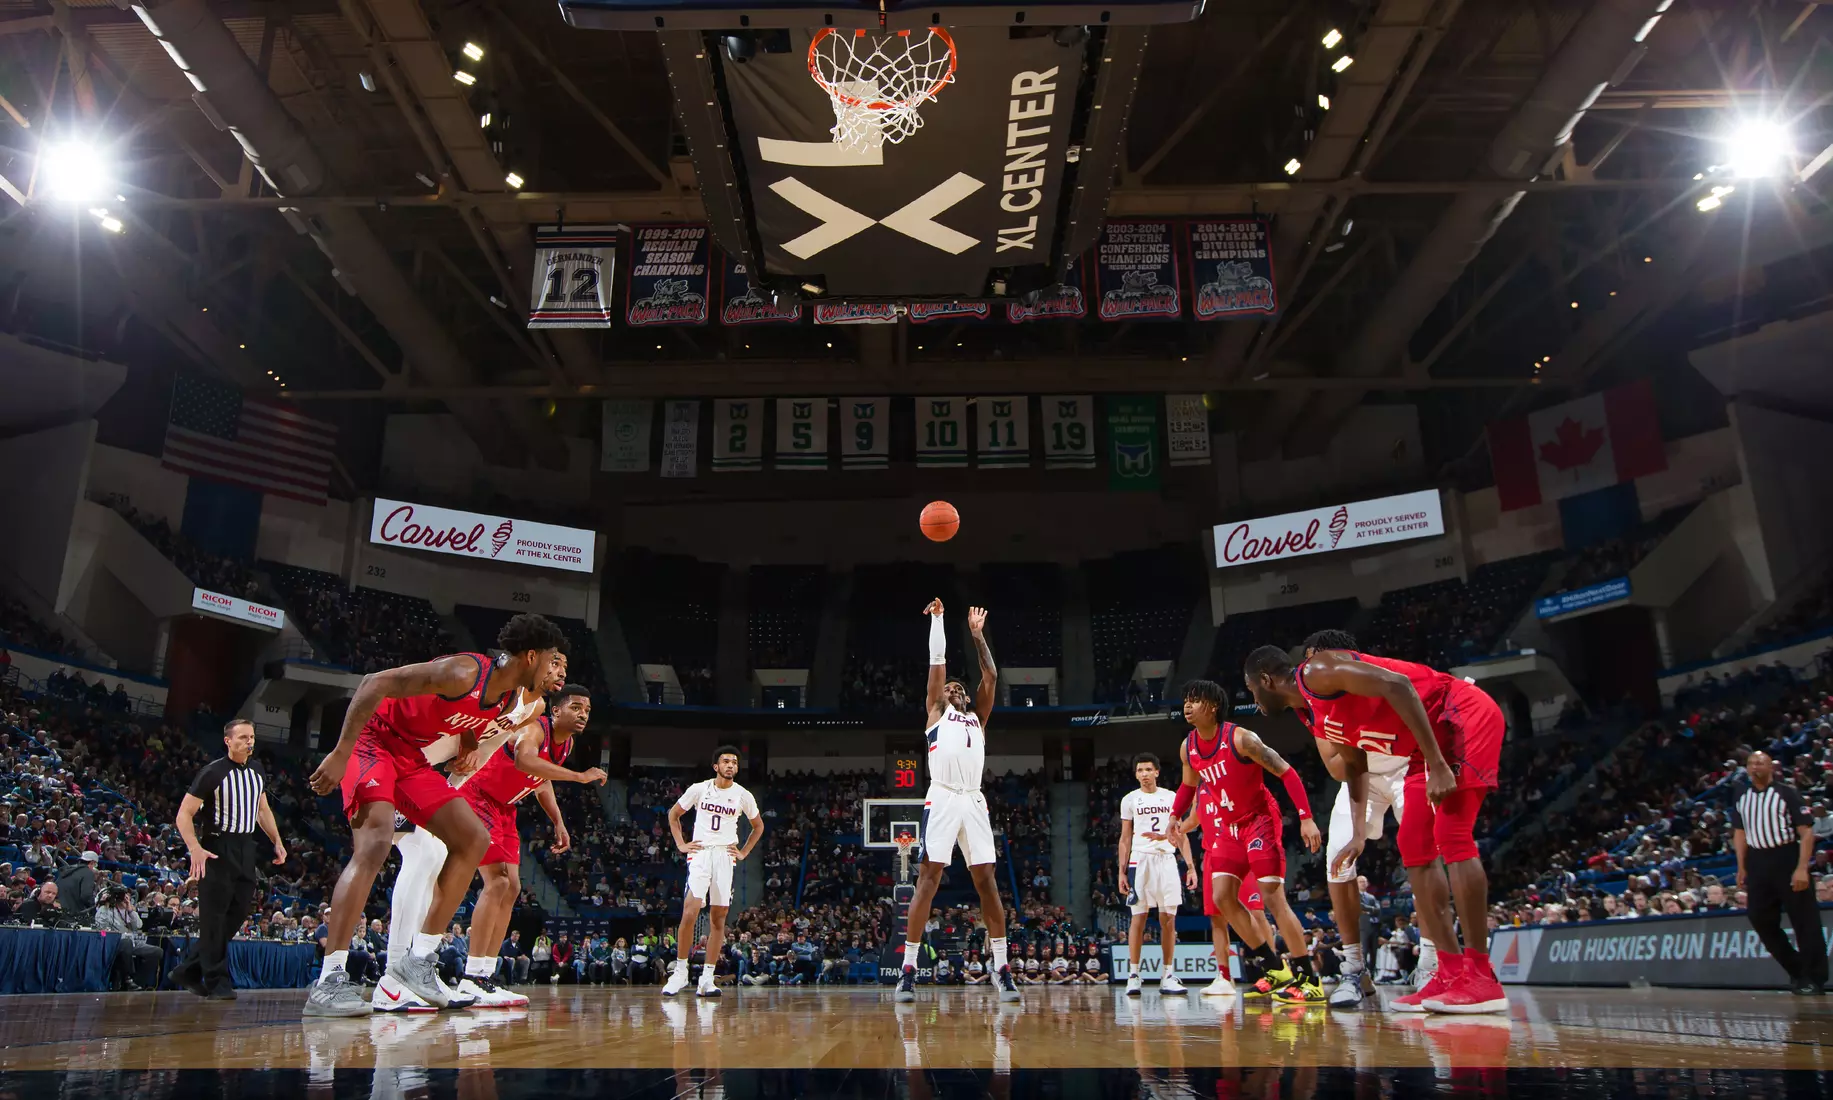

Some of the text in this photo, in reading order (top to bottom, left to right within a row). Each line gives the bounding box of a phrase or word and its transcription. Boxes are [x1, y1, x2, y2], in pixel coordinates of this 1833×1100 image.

[996, 65, 1059, 253] XL CENTER
[637, 229, 705, 241] 1999-2000
[1106, 224, 1166, 234] 2003-2004
[1108, 234, 1163, 244] EASTERN
[1193, 232, 1265, 243] NORTHEAST
[641, 240, 699, 252] REGULAR
[1100, 244, 1170, 254] CONFERENCE
[1202, 242, 1256, 251] DIVISION
[645, 252, 694, 264] SEASON
[1100, 254, 1169, 264] CHAMPIONS
[1195, 249, 1267, 259] CHAMPIONS
[634, 264, 704, 276] CHAMPIONS
[546, 268, 600, 302] 12
[729, 424, 748, 453] 2
[792, 422, 812, 450] 5
[854, 421, 874, 450] 9
[926, 421, 958, 447] 10
[989, 420, 1017, 447] 11
[1053, 422, 1087, 450] 19
[1355, 511, 1427, 529] PROUDLY SERVED
[381, 505, 484, 553] Carvel
[1356, 521, 1429, 538] AT THE XL CENTER
[517, 539, 582, 555] PROUDLY SERVED
[1223, 518, 1320, 563] Carvel
[527, 549, 542, 557] THE
[543, 551, 552, 559] XL
[554, 553, 582, 564] CENTER
[367, 565, 386, 578] 232
[202, 593, 232, 606] RICOH
[512, 592, 530, 603] 233
[248, 605, 277, 618] RICOH
[265, 705, 281, 714] 107
[444, 712, 489, 730] NJIT
[947, 712, 979, 729] UCNN
[896, 759, 917, 769] 9:34
[895, 769, 915, 788] 30
[1199, 760, 1228, 786] NJIT
[1220, 788, 1235, 812] 4
[701, 802, 736, 815] UCONN
[1136, 806, 1170, 815] UCONN
[711, 815, 721, 831] 0
[1151, 816, 1161, 832] 2
[1549, 939, 1583, 962] OUR
[1583, 934, 1657, 961] HUSKIES
[1659, 932, 1706, 960] RUN
[880, 967, 933, 977] TRAVERS
[1114, 958, 1217, 972] TAVLERS
